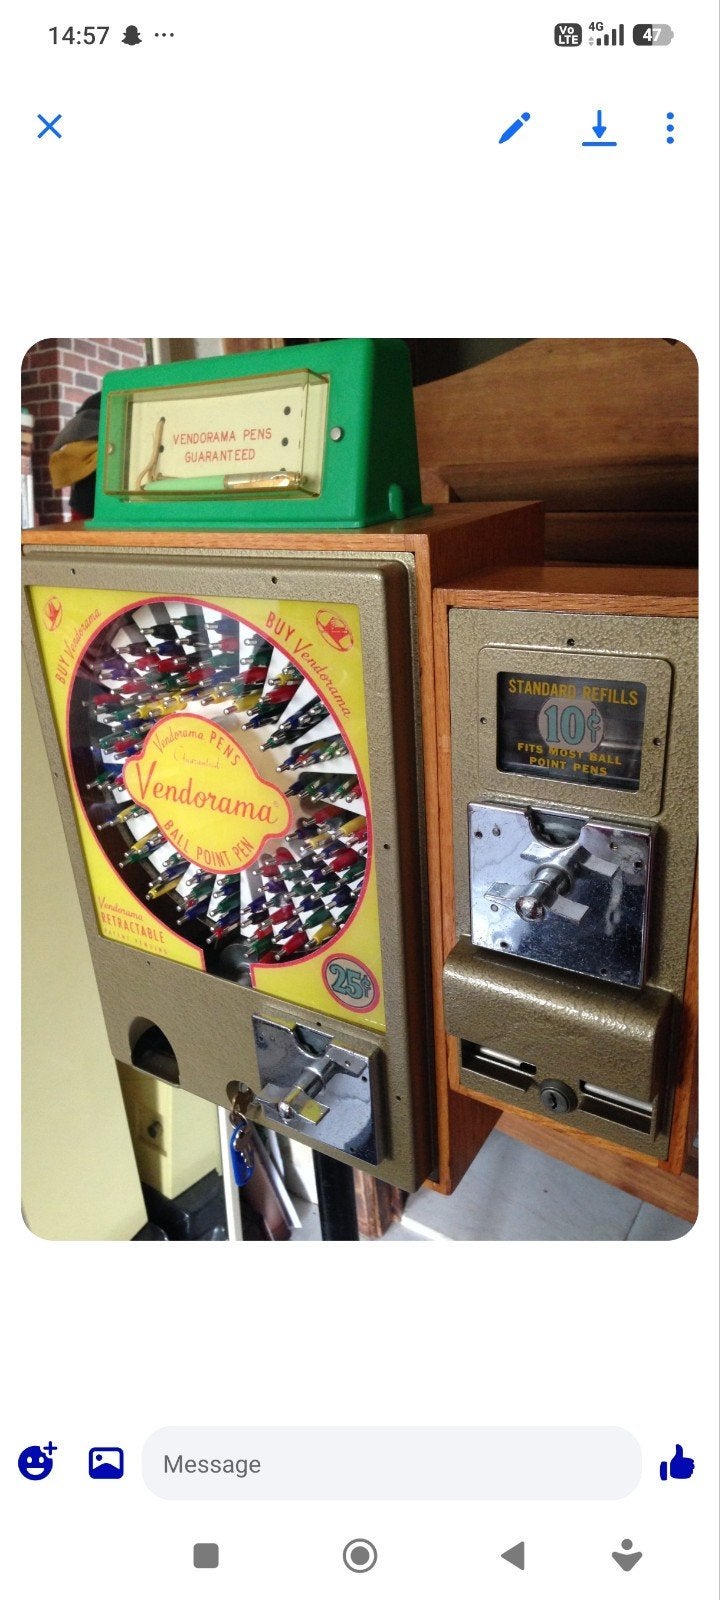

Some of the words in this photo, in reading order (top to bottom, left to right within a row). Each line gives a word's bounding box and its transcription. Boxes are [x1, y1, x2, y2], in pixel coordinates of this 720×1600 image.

[49, 26, 110, 45] 14:57
[588, 21, 604, 32] 4G
[642, 27, 662, 42] 47
[558, 35, 579, 45] LTE
[173, 430, 237, 445] VENDORAMA
[243, 427, 272, 441] PENS
[184, 448, 256, 463] GUARANTEED
[55, 654, 70, 685] BUY
[64, 608, 103, 660] Vendorama
[265, 610, 296, 642] BUY
[293, 638, 352, 718] Vendorama
[508, 678, 577, 699] STANDARD
[583, 686, 638, 706] REFILLS
[544, 704, 602, 746] 10¢
[153, 726, 206, 755] Vendorama
[208, 730, 241, 767] PENS
[517, 742, 544, 755] FITS
[549, 747, 584, 760] MOST
[588, 753, 623, 766] BALL
[529, 757, 568, 770] POINT
[573, 763, 608, 776] PENS
[135, 761, 280, 825] Vendorama
[163, 819, 190, 853] BALL
[196, 846, 232, 869] POINT
[231, 836, 255, 863] PEN
[98, 896, 144, 922] Vendorama
[100, 911, 166, 944] RETRACTABLE
[329, 963, 371, 1000] 25¢
[163, 1454, 262, 1479] Message
